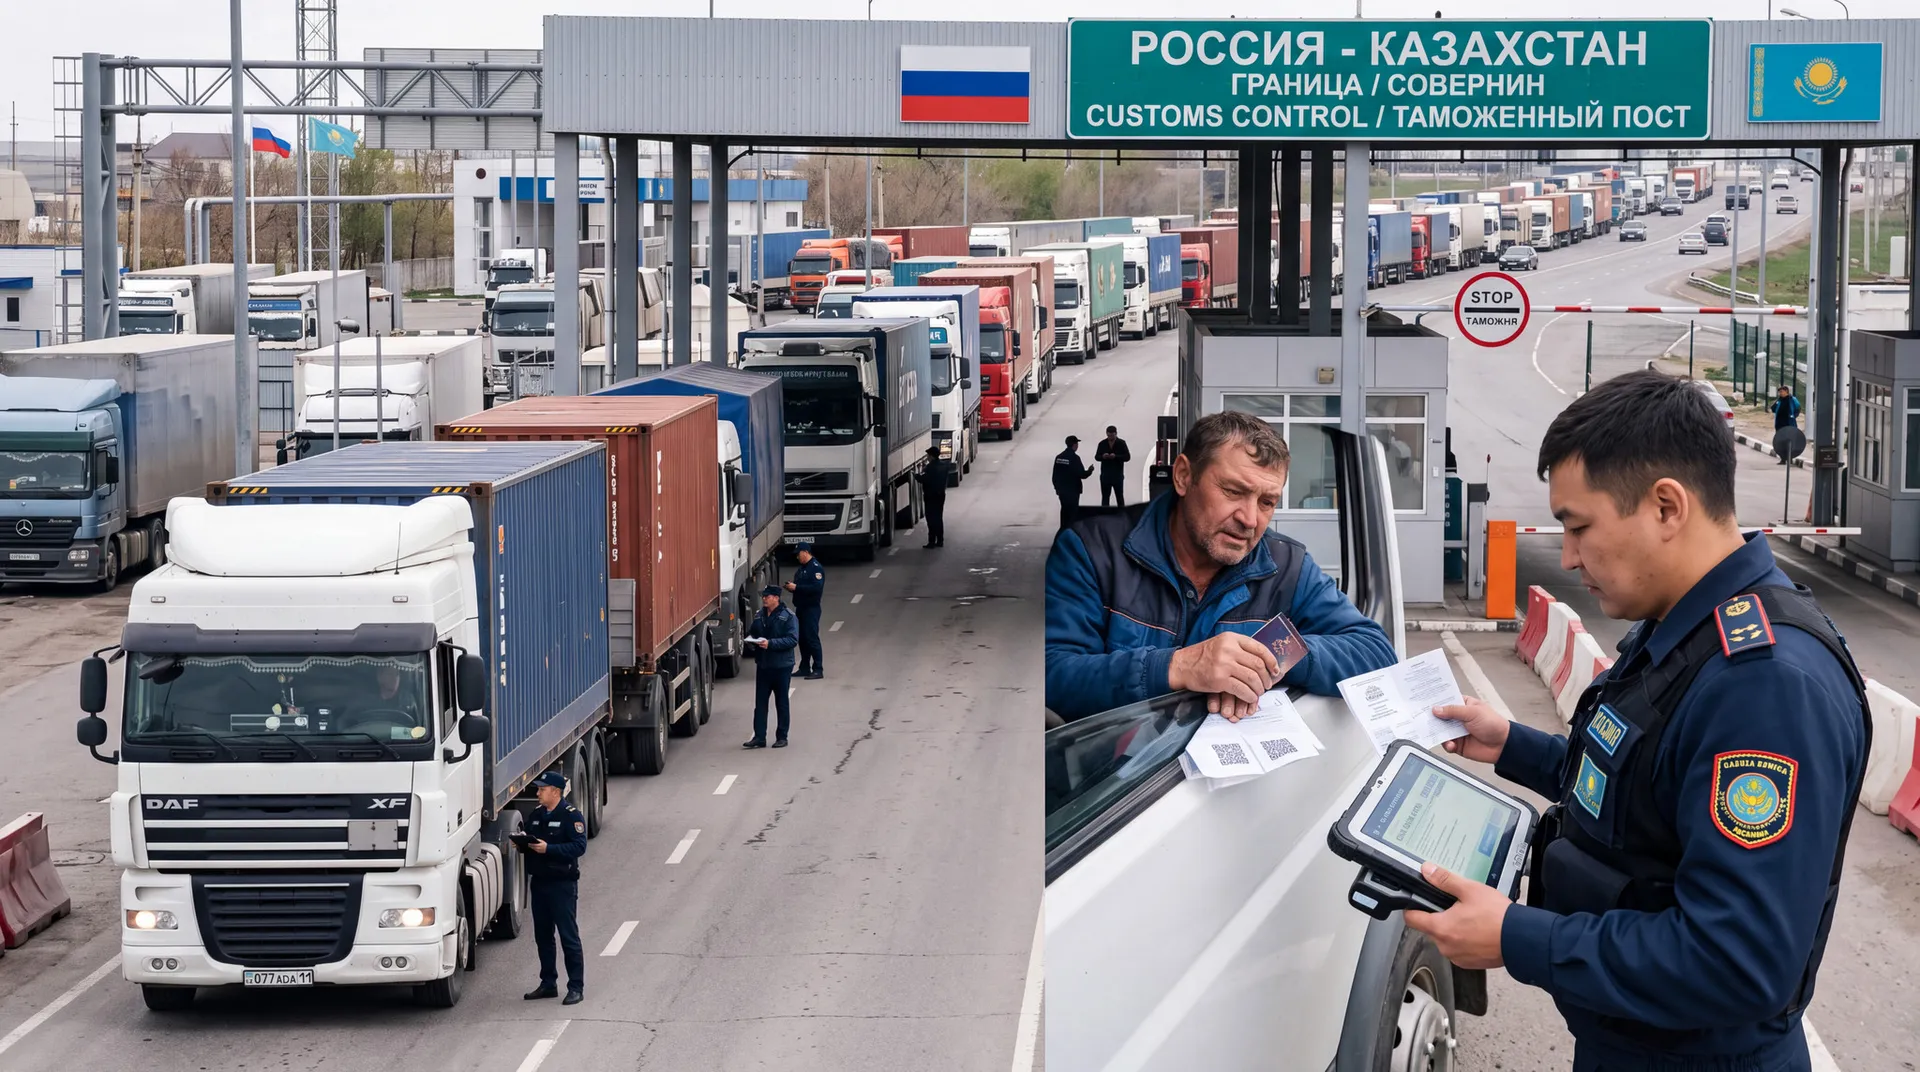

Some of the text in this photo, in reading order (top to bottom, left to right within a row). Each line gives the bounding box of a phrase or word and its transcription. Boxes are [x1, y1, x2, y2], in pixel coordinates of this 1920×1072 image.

[1131, 30, 1324, 66] РОССИЯ
[1371, 30, 1647, 66] КАЗАХСТАН
[1231, 73, 1545, 101] ГРАНИЦА / СОВЕРНИН
[1086, 100, 1691, 128] CUSTOMS CONTROL / ТАМОЖЕННЫЙ ПОСТ
[1471, 291, 1514, 304] STOP
[145, 799, 199, 810] DAF
[367, 798, 407, 810] XF
[254, 972, 312, 984] 077 ADA 11
